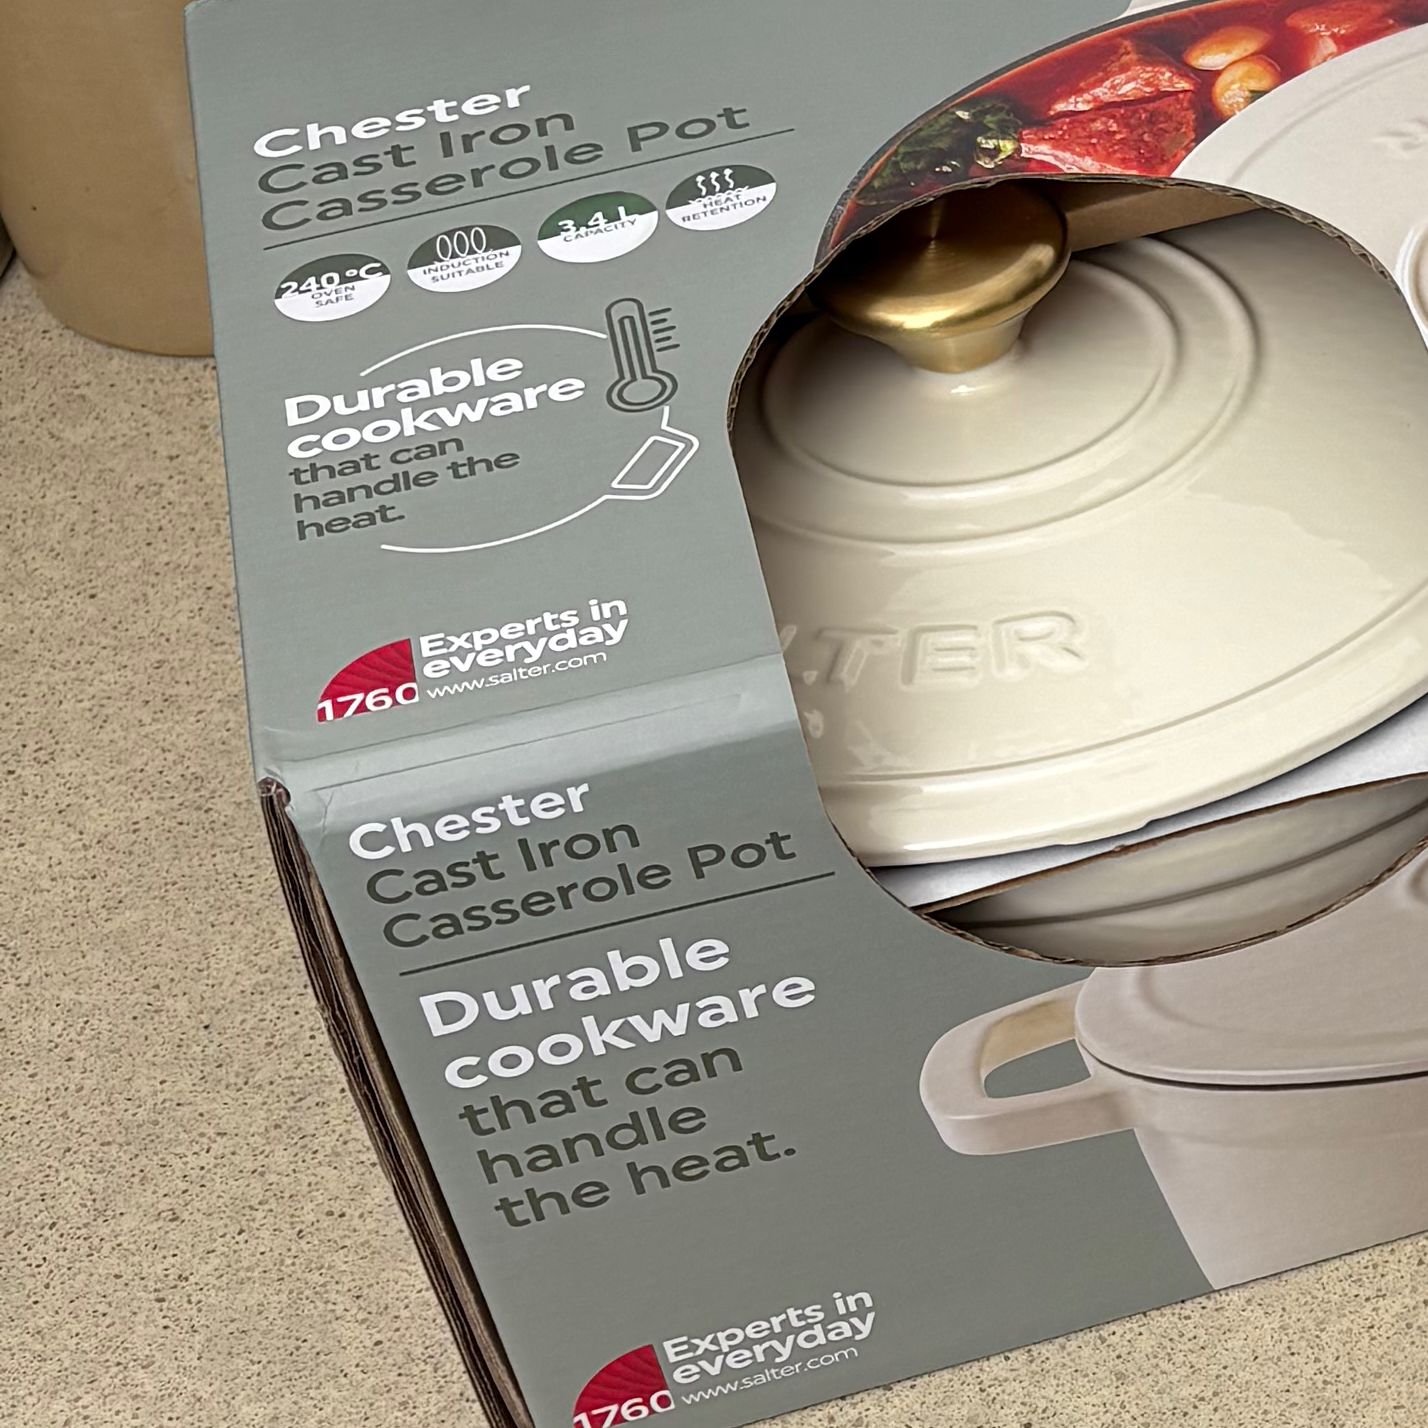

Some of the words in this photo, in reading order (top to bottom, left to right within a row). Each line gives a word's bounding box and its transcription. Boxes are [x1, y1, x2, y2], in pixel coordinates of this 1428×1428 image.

[253, 84, 531, 158] Chester
[258, 143, 417, 194] Cast
[439, 112, 575, 158] Iron
[261, 142, 604, 231] Casserole
[627, 107, 750, 153] Pot
[557, 210, 609, 238] 3.4
[562, 218, 637, 243] CAPACITY
[681, 195, 768, 223] RETENTION
[703, 193, 743, 209] HEAT
[311, 283, 356, 300] OVEN
[422, 249, 510, 275] INDUCTION
[431, 260, 505, 283] SUITABLE
[314, 293, 355, 308] SAFE
[285, 357, 524, 426] Durable
[287, 377, 587, 459] cookware
[289, 452, 381, 486] that
[389, 437, 465, 466] can
[294, 470, 439, 514] handle
[447, 452, 521, 480] the
[297, 504, 406, 541] heat.
[420, 608, 580, 658] Experts
[588, 598, 628, 622] in
[422, 618, 630, 680] everyday
[316, 681, 421, 722] 1760
[426, 649, 608, 700] www.salter.com
[349, 782, 590, 861] Chester
[366, 848, 506, 905] Cast
[517, 823, 641, 873] Iron
[383, 862, 672, 948] Casserole
[687, 830, 797, 880] Pot
[418, 937, 731, 1038] Durable
[445, 975, 817, 1089] cookware
[458, 1075, 609, 1137] that
[624, 1046, 743, 1096] can
[476, 1105, 708, 1186] handle
[494, 1179, 611, 1228] the
[626, 1130, 797, 1197] heat.
[662, 1304, 826, 1363] Experts
[832, 1290, 874, 1315] in
[672, 1311, 876, 1385] everyday
[681, 1345, 859, 1405] www.salter.com
